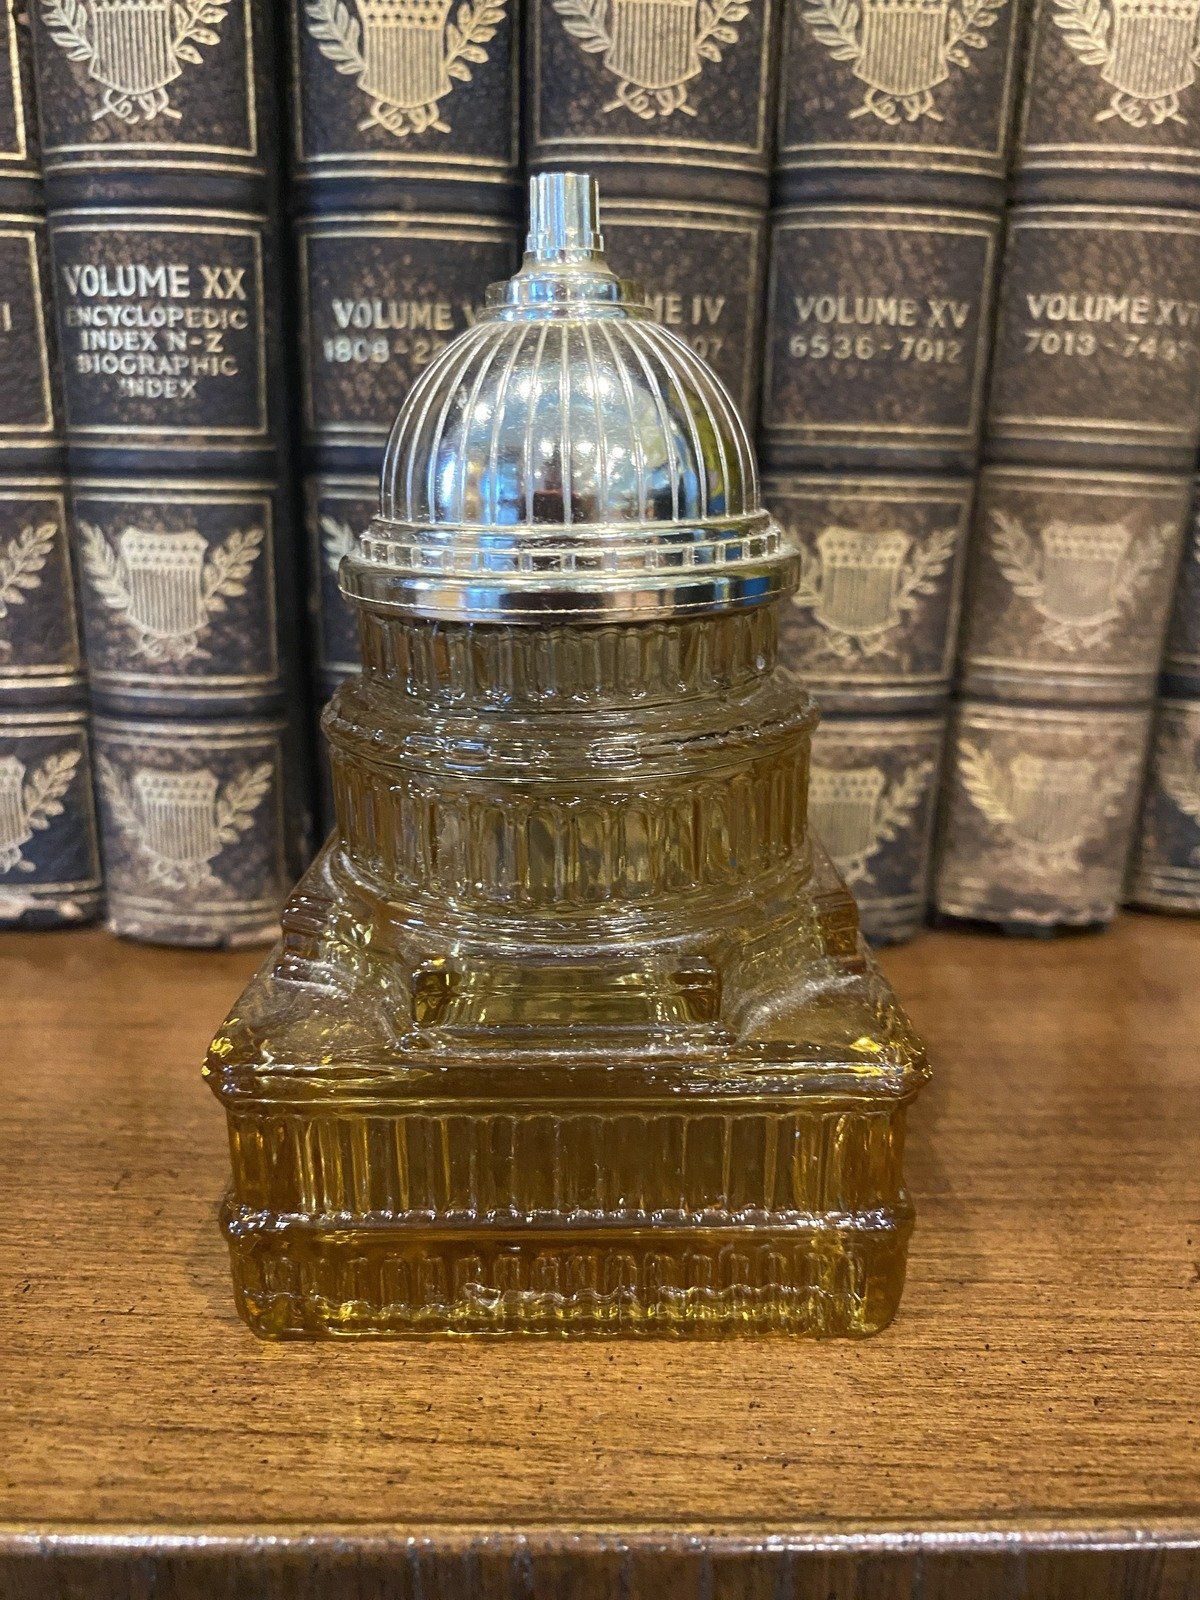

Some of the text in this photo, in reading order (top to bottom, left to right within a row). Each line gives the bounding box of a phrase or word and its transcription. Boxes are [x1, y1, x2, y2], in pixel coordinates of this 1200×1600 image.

[63, 263, 247, 300] VOLUME XX
[66, 305, 249, 330] ENCYCLOPEDIC
[332, 298, 455, 331] VOLUME
[691, 294, 726, 325] IV
[795, 295, 970, 329] VOLUME XV
[1026, 293, 1150, 325] VOLUME
[80, 329, 158, 351] INDEX
[76, 353, 239, 376] BIOGRAPHIC
